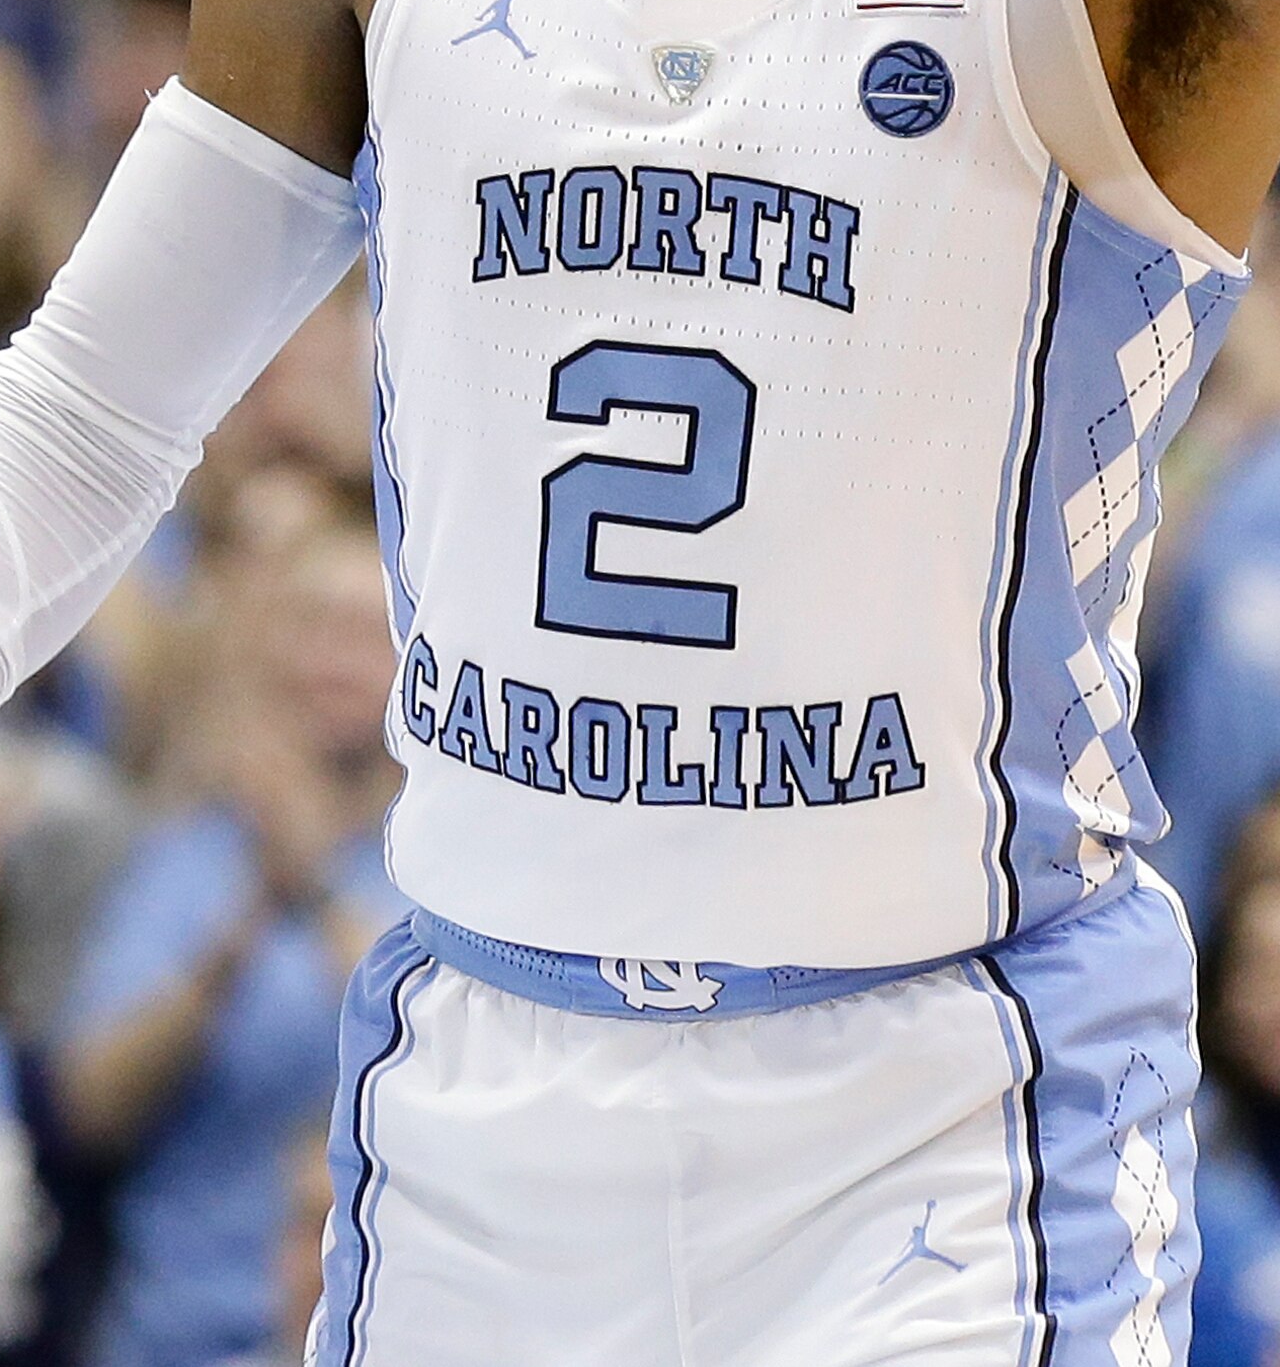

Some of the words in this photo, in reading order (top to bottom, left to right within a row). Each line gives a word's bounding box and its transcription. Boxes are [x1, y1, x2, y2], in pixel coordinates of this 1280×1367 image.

[873, 73, 945, 94] ACC
[473, 166, 860, 313] NORTH
[535, 339, 757, 650] 2
[402, 633, 925, 810] CAROLINA
